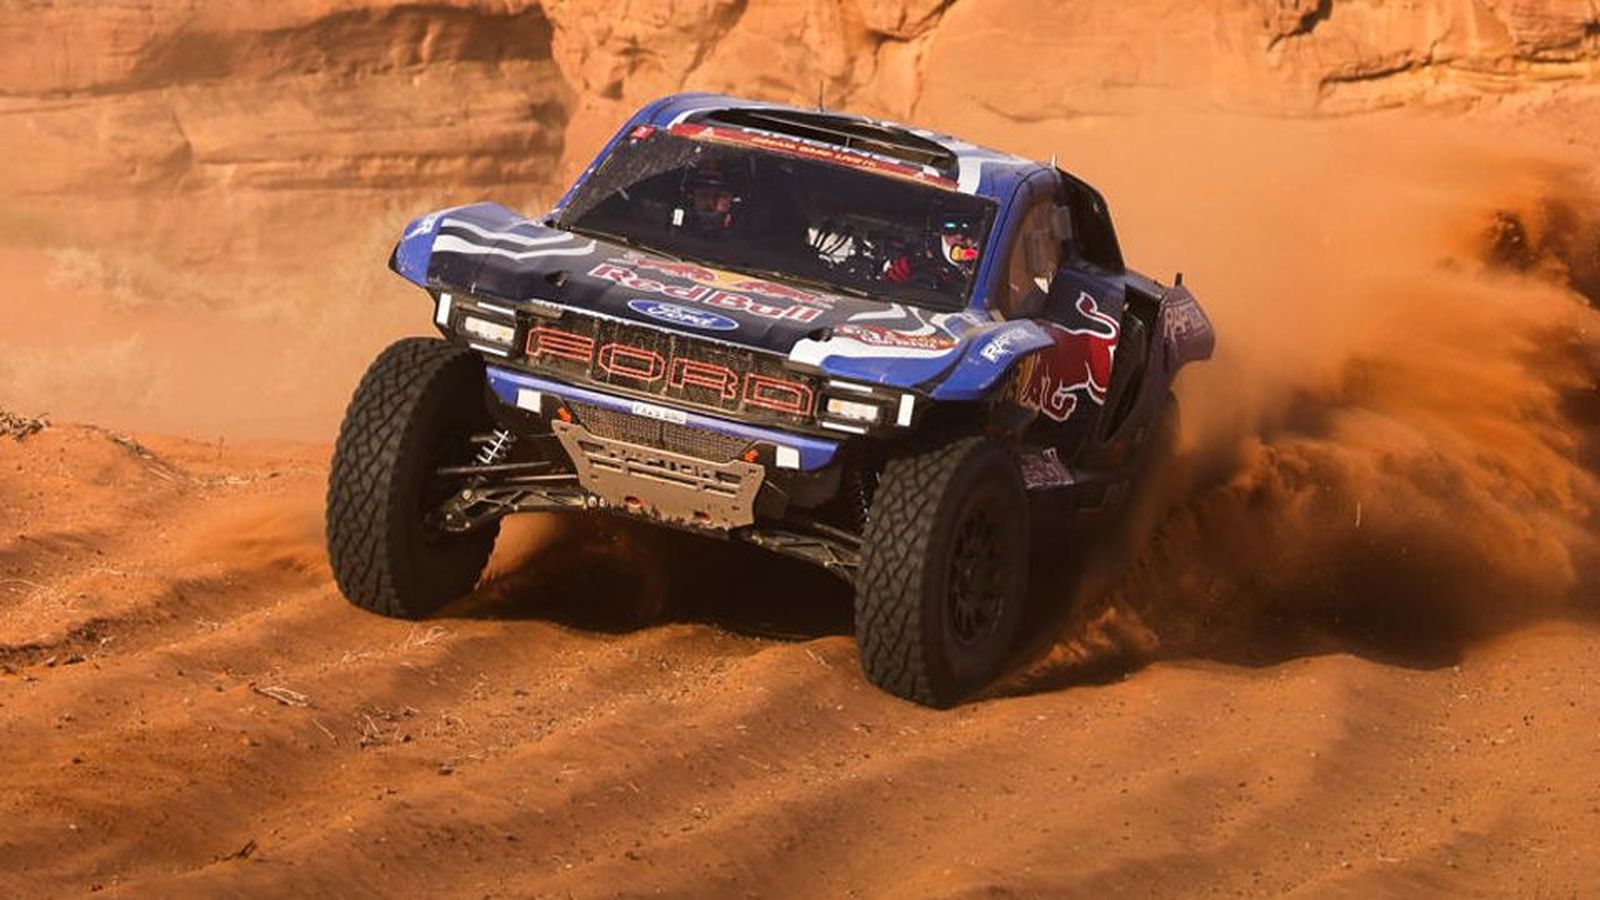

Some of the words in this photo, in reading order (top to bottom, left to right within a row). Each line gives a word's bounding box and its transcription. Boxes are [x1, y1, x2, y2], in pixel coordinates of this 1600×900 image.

[587, 262, 711, 302] Red
[703, 289, 825, 323] Bull
[644, 302, 722, 328] Ford
[525, 326, 814, 417] FORD
